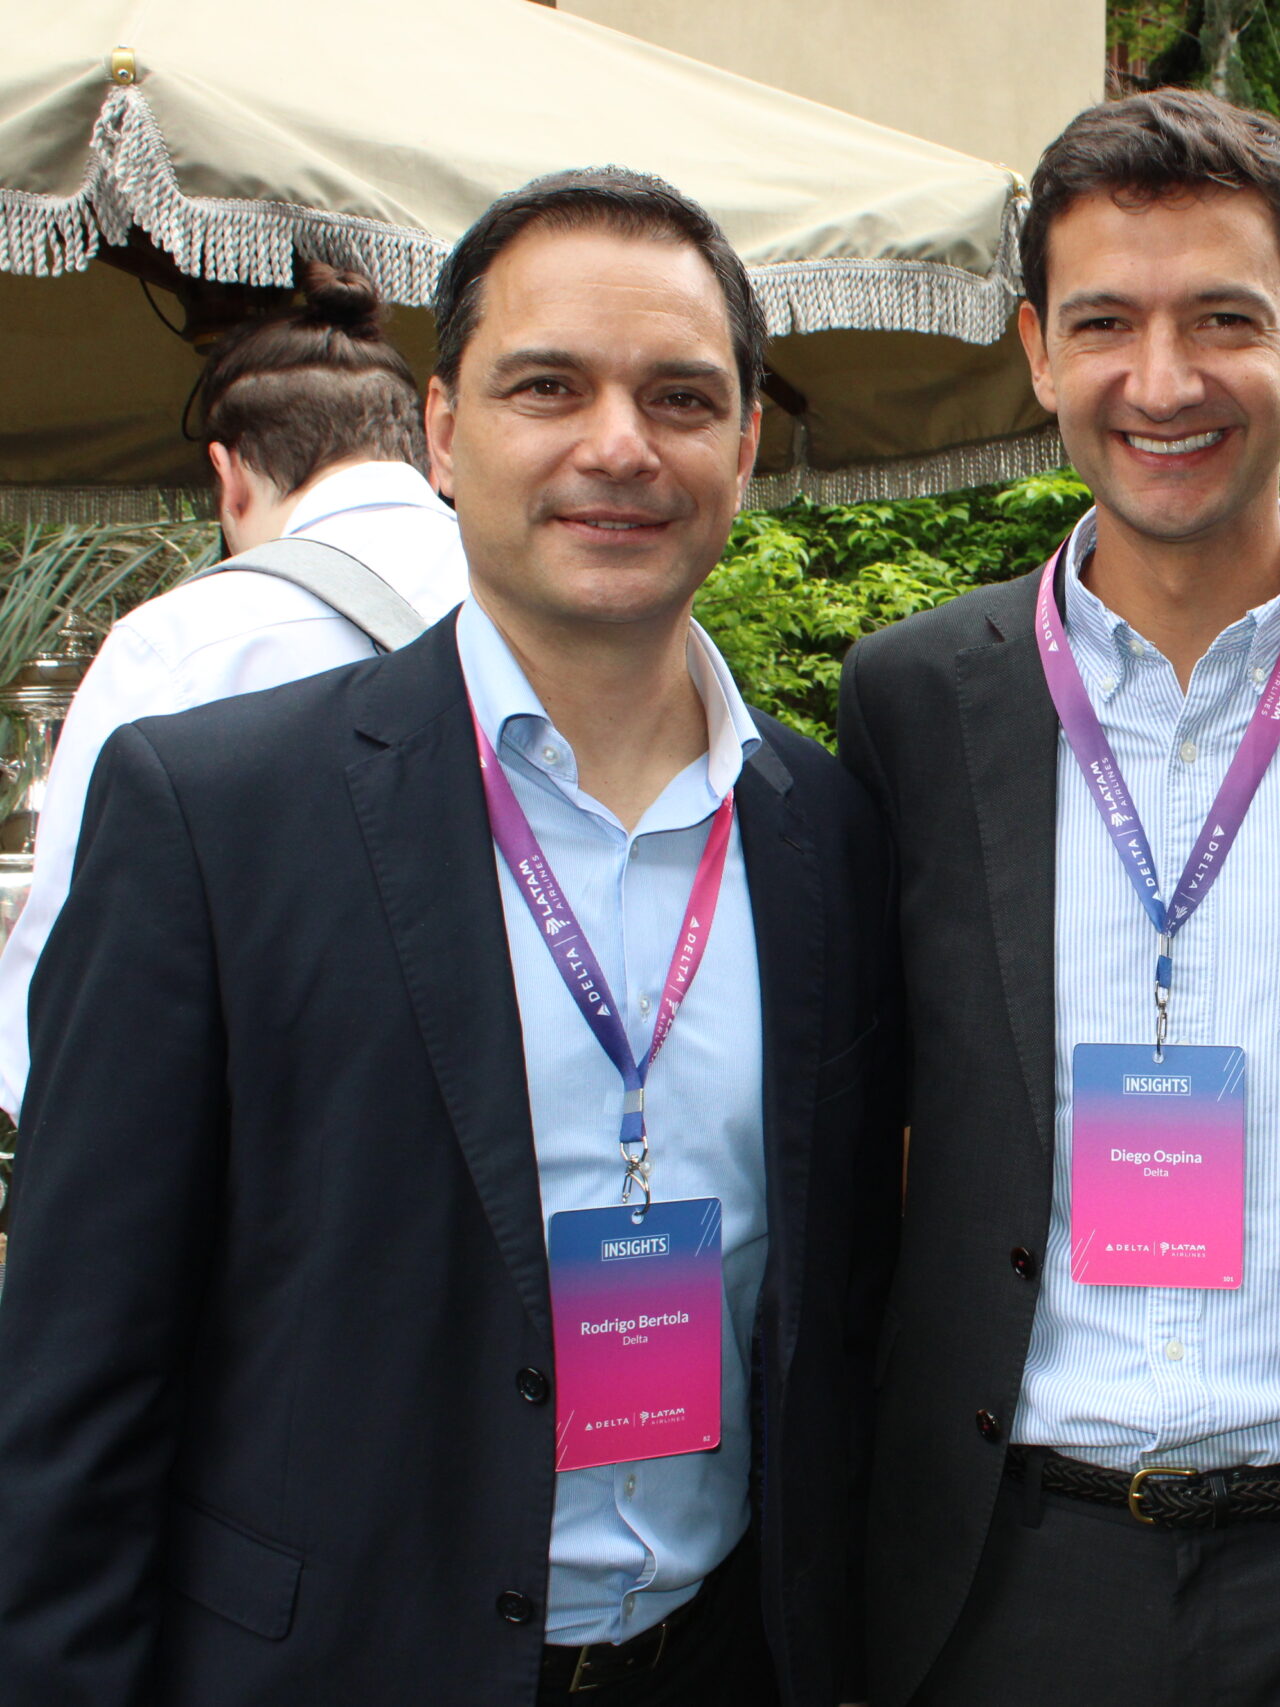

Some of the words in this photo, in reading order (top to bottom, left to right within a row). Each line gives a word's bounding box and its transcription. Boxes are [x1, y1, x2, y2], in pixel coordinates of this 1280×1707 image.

[1090, 760, 1118, 812] LATAM
[1102, 757, 1127, 807] AIRLINES
[1128, 838, 1156, 887] DELTA
[1189, 841, 1219, 889] DELTA
[518, 859, 553, 917] LATAM
[532, 854, 564, 910] AIRLINES
[676, 932, 697, 983] DELTA
[566, 947, 601, 1003] DELTA
[1125, 1077, 1188, 1094] INSIGHTS
[1110, 1148, 1151, 1165] Diego
[1153, 1149, 1203, 1166] Ospina
[1143, 1167, 1169, 1177] Delta
[604, 1237, 667, 1259] INSIGHTS
[1116, 1244, 1150, 1252] DELTA
[1171, 1243, 1206, 1251] LATAM
[581, 1318, 636, 1336] Rodrigo
[639, 1310, 690, 1328] Bertola
[622, 1334, 649, 1346] Delta
[595, 1417, 630, 1429] DELTA
[651, 1407, 686, 1418] LATAM
[651, 1416, 686, 1425] AIRLINES
